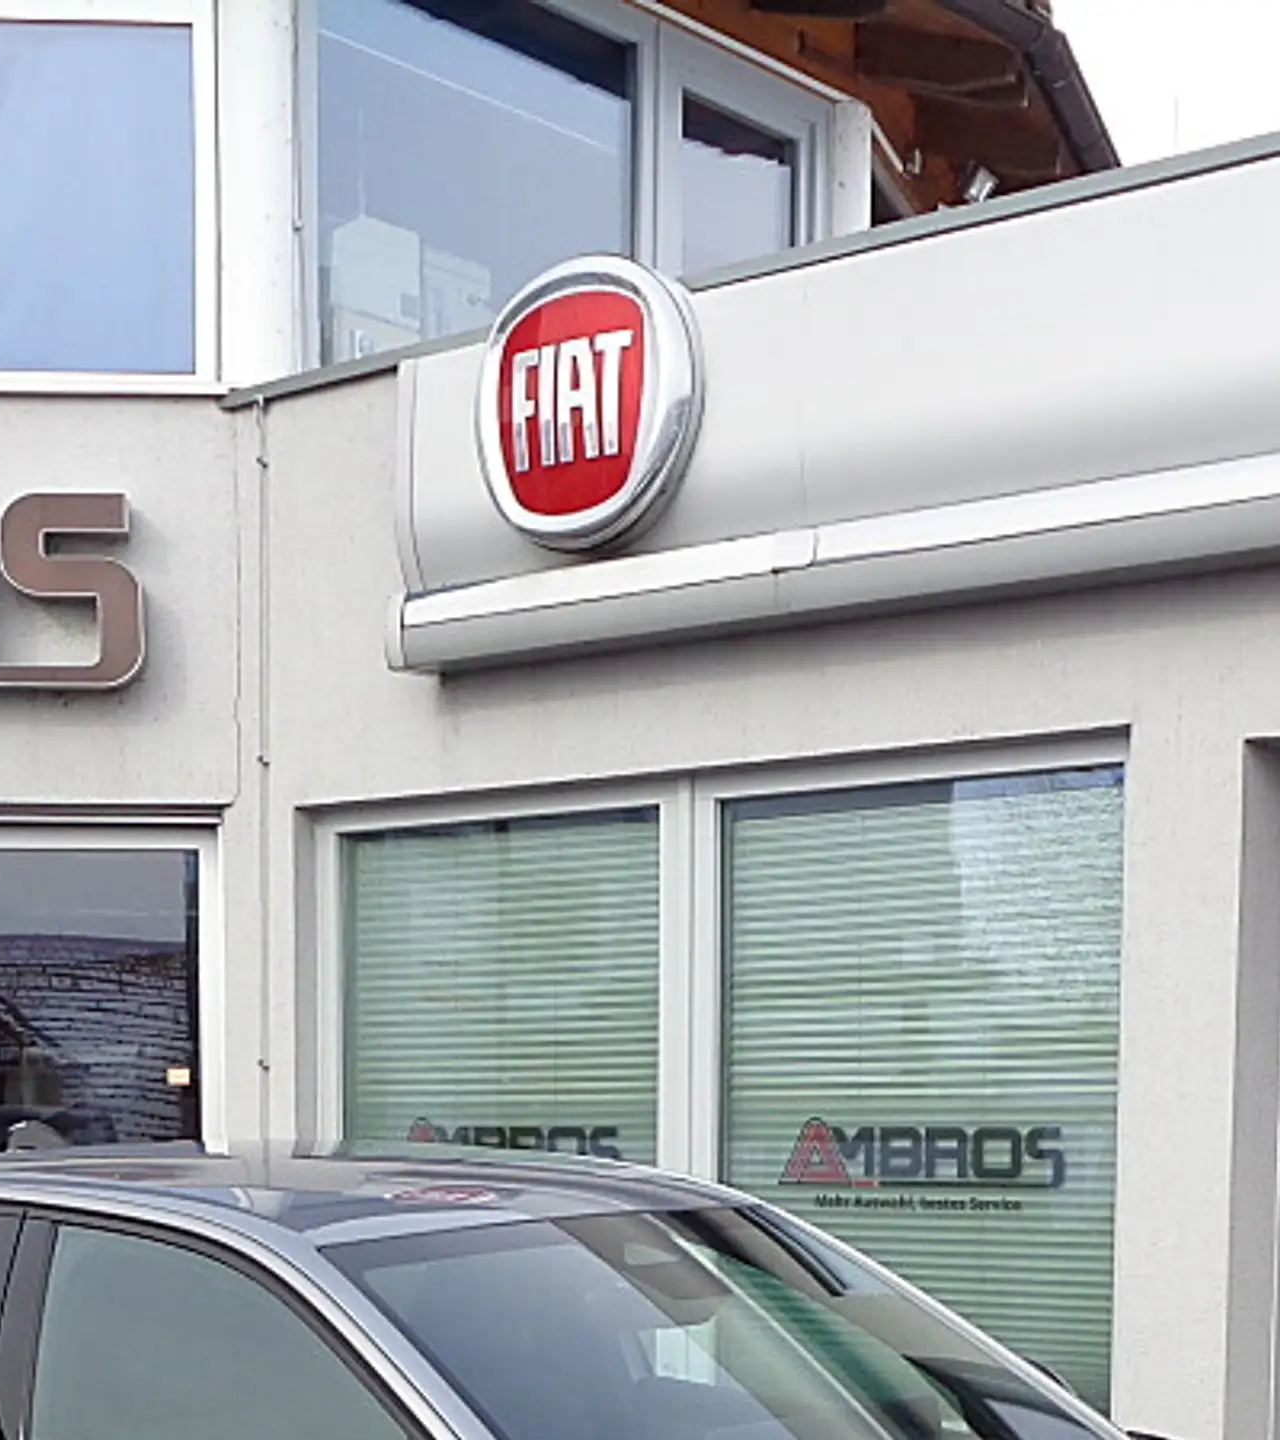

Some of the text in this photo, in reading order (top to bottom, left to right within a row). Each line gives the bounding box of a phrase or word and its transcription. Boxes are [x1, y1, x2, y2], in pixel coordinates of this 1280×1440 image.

[511, 328, 635, 473] FIAT
[778, 1116, 1066, 1188] AMBROS
[969, 1195, 1022, 1211] Service
